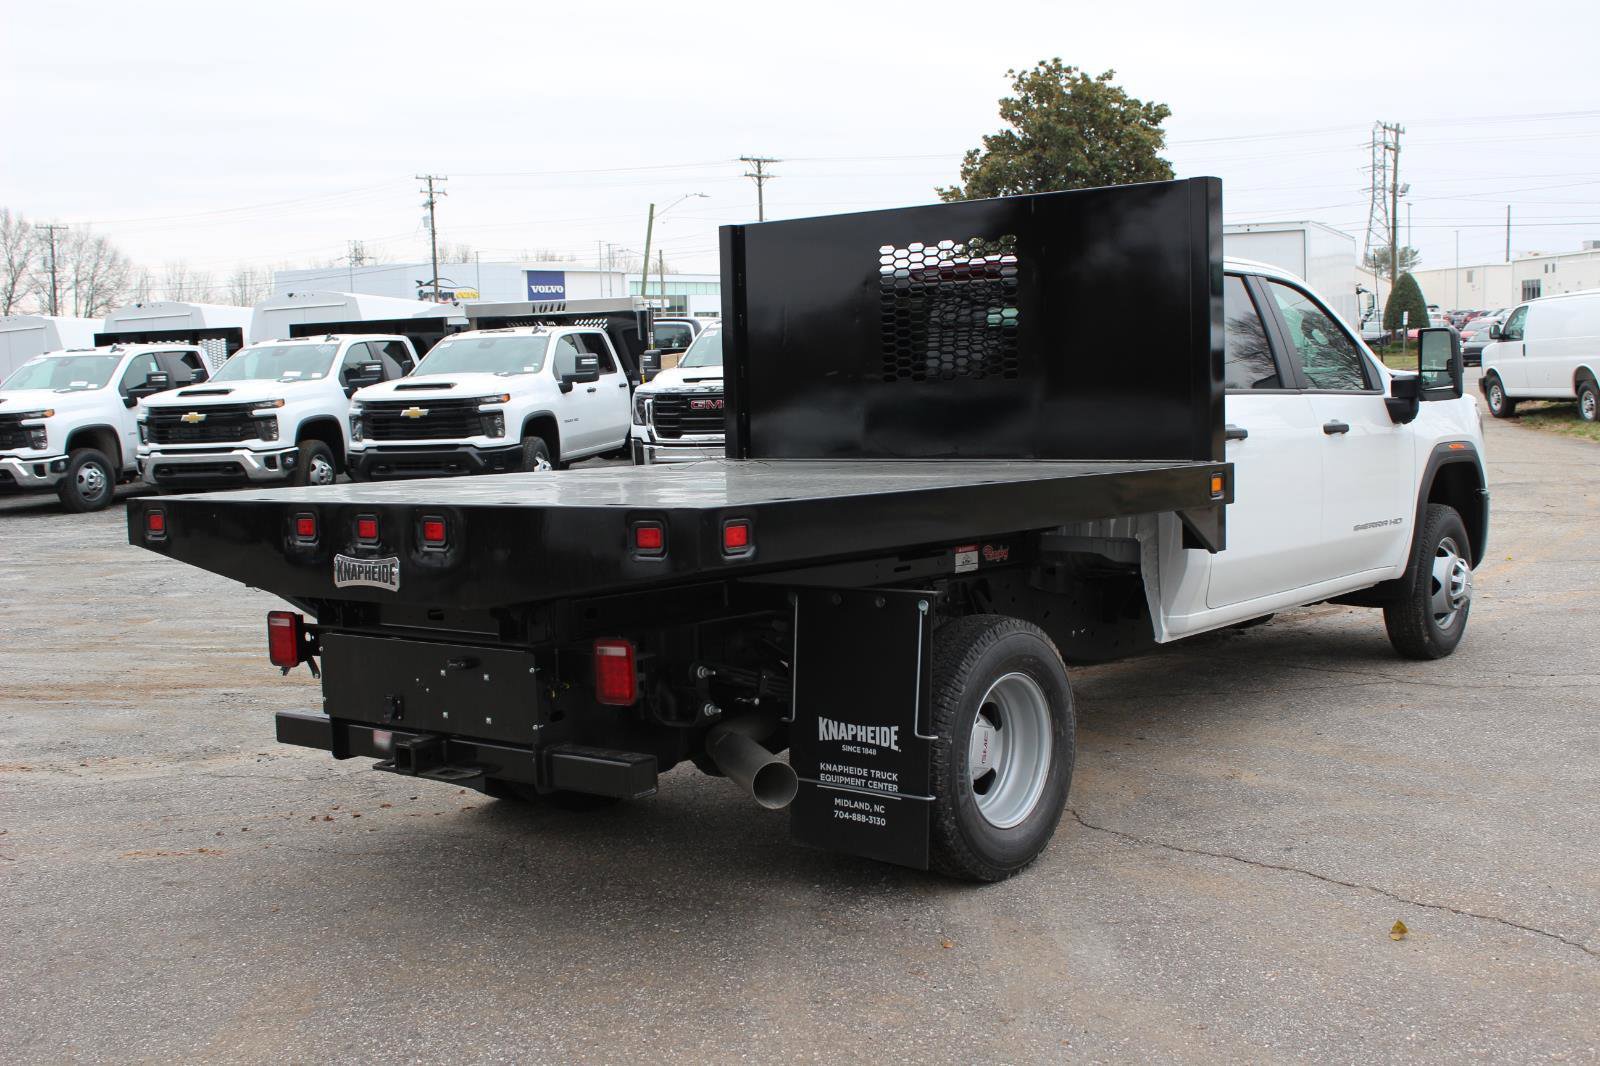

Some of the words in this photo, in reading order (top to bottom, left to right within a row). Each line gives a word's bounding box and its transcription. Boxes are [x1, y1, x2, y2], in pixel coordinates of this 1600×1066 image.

[530, 285, 564, 294] VOLVO
[690, 399, 724, 410] GM
[1353, 520, 1388, 532] SIERRA
[1389, 517, 1403, 526] HD
[336, 559, 397, 586] KNAPHEIDE
[818, 716, 899, 752] KNAPHEIDE
[841, 744, 861, 754] SINCE
[862, 746, 877, 756] 1848
[820, 762, 868, 777] KNAPHEIDE
[870, 769, 898, 781] TRUCK
[820, 773, 866, 788] EQUIPMENT
[867, 780, 898, 793] CENTER
[834, 797, 873, 812] MIDLAND,
[874, 804, 885, 814] NC
[833, 810, 886, 826] 704-888-3130
